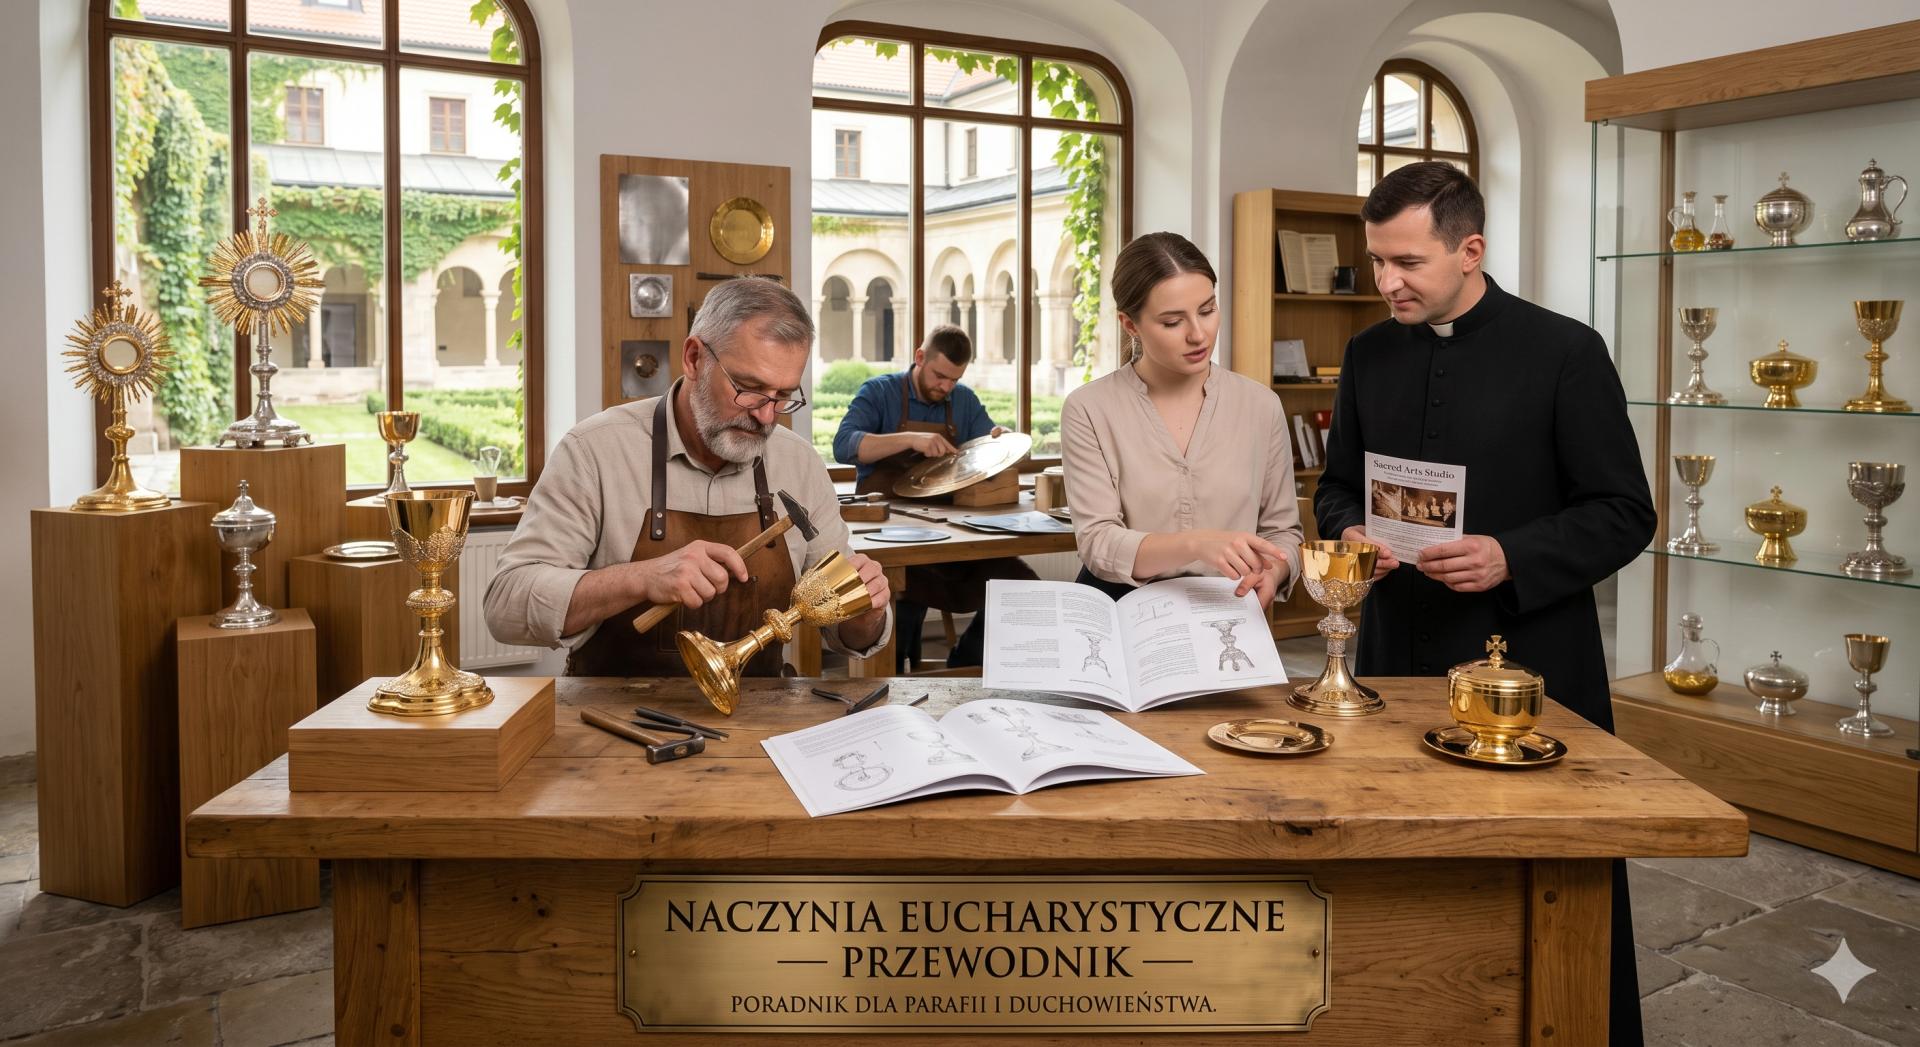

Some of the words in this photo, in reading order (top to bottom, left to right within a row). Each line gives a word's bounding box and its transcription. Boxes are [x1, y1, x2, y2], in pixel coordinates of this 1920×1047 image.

[1373, 459, 1402, 472] Sacred
[1404, 467, 1423, 476] Arts
[1424, 468, 1455, 479] Studio
[664, 899, 888, 933] NACZYNIA
[898, 899, 1286, 934] EUCHARYSTYCZNE
[842, 945, 1134, 979] PRZEWODNIK
[730, 995, 850, 1014] PORADNIK
[855, 995, 899, 1014] DLA
[904, 995, 987, 1014] PARAFII
[995, 995, 1001, 1014] I
[1009, 990, 1217, 1014] DUCHOWIEŃSTWA.
